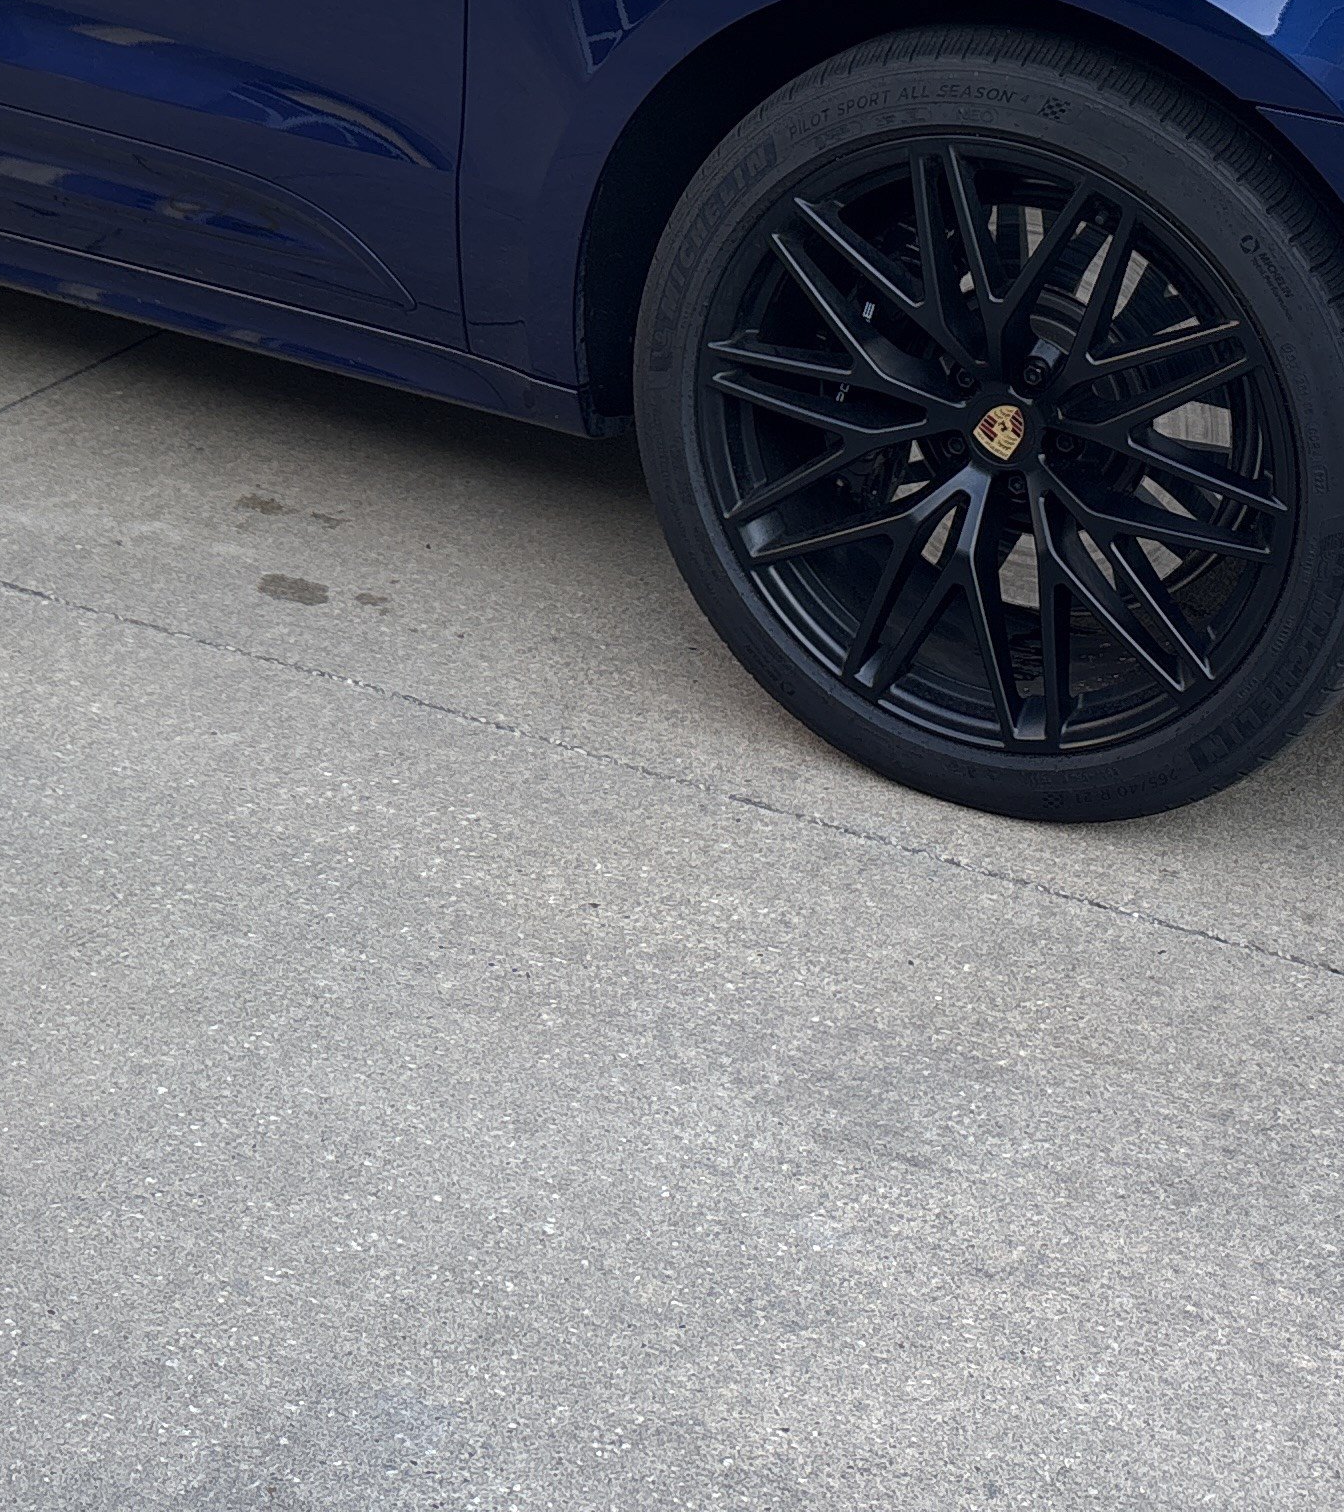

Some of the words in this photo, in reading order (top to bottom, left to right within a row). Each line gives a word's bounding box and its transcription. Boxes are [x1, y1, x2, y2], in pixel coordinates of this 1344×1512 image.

[789, 108, 829, 139] PILOT
[837, 90, 892, 117] SPORT
[897, 85, 930, 102] ALL
[936, 84, 1015, 103] SEASON
[660, 141, 778, 320] MICHELIN
[1202, 590, 1336, 762] MICHELIN
